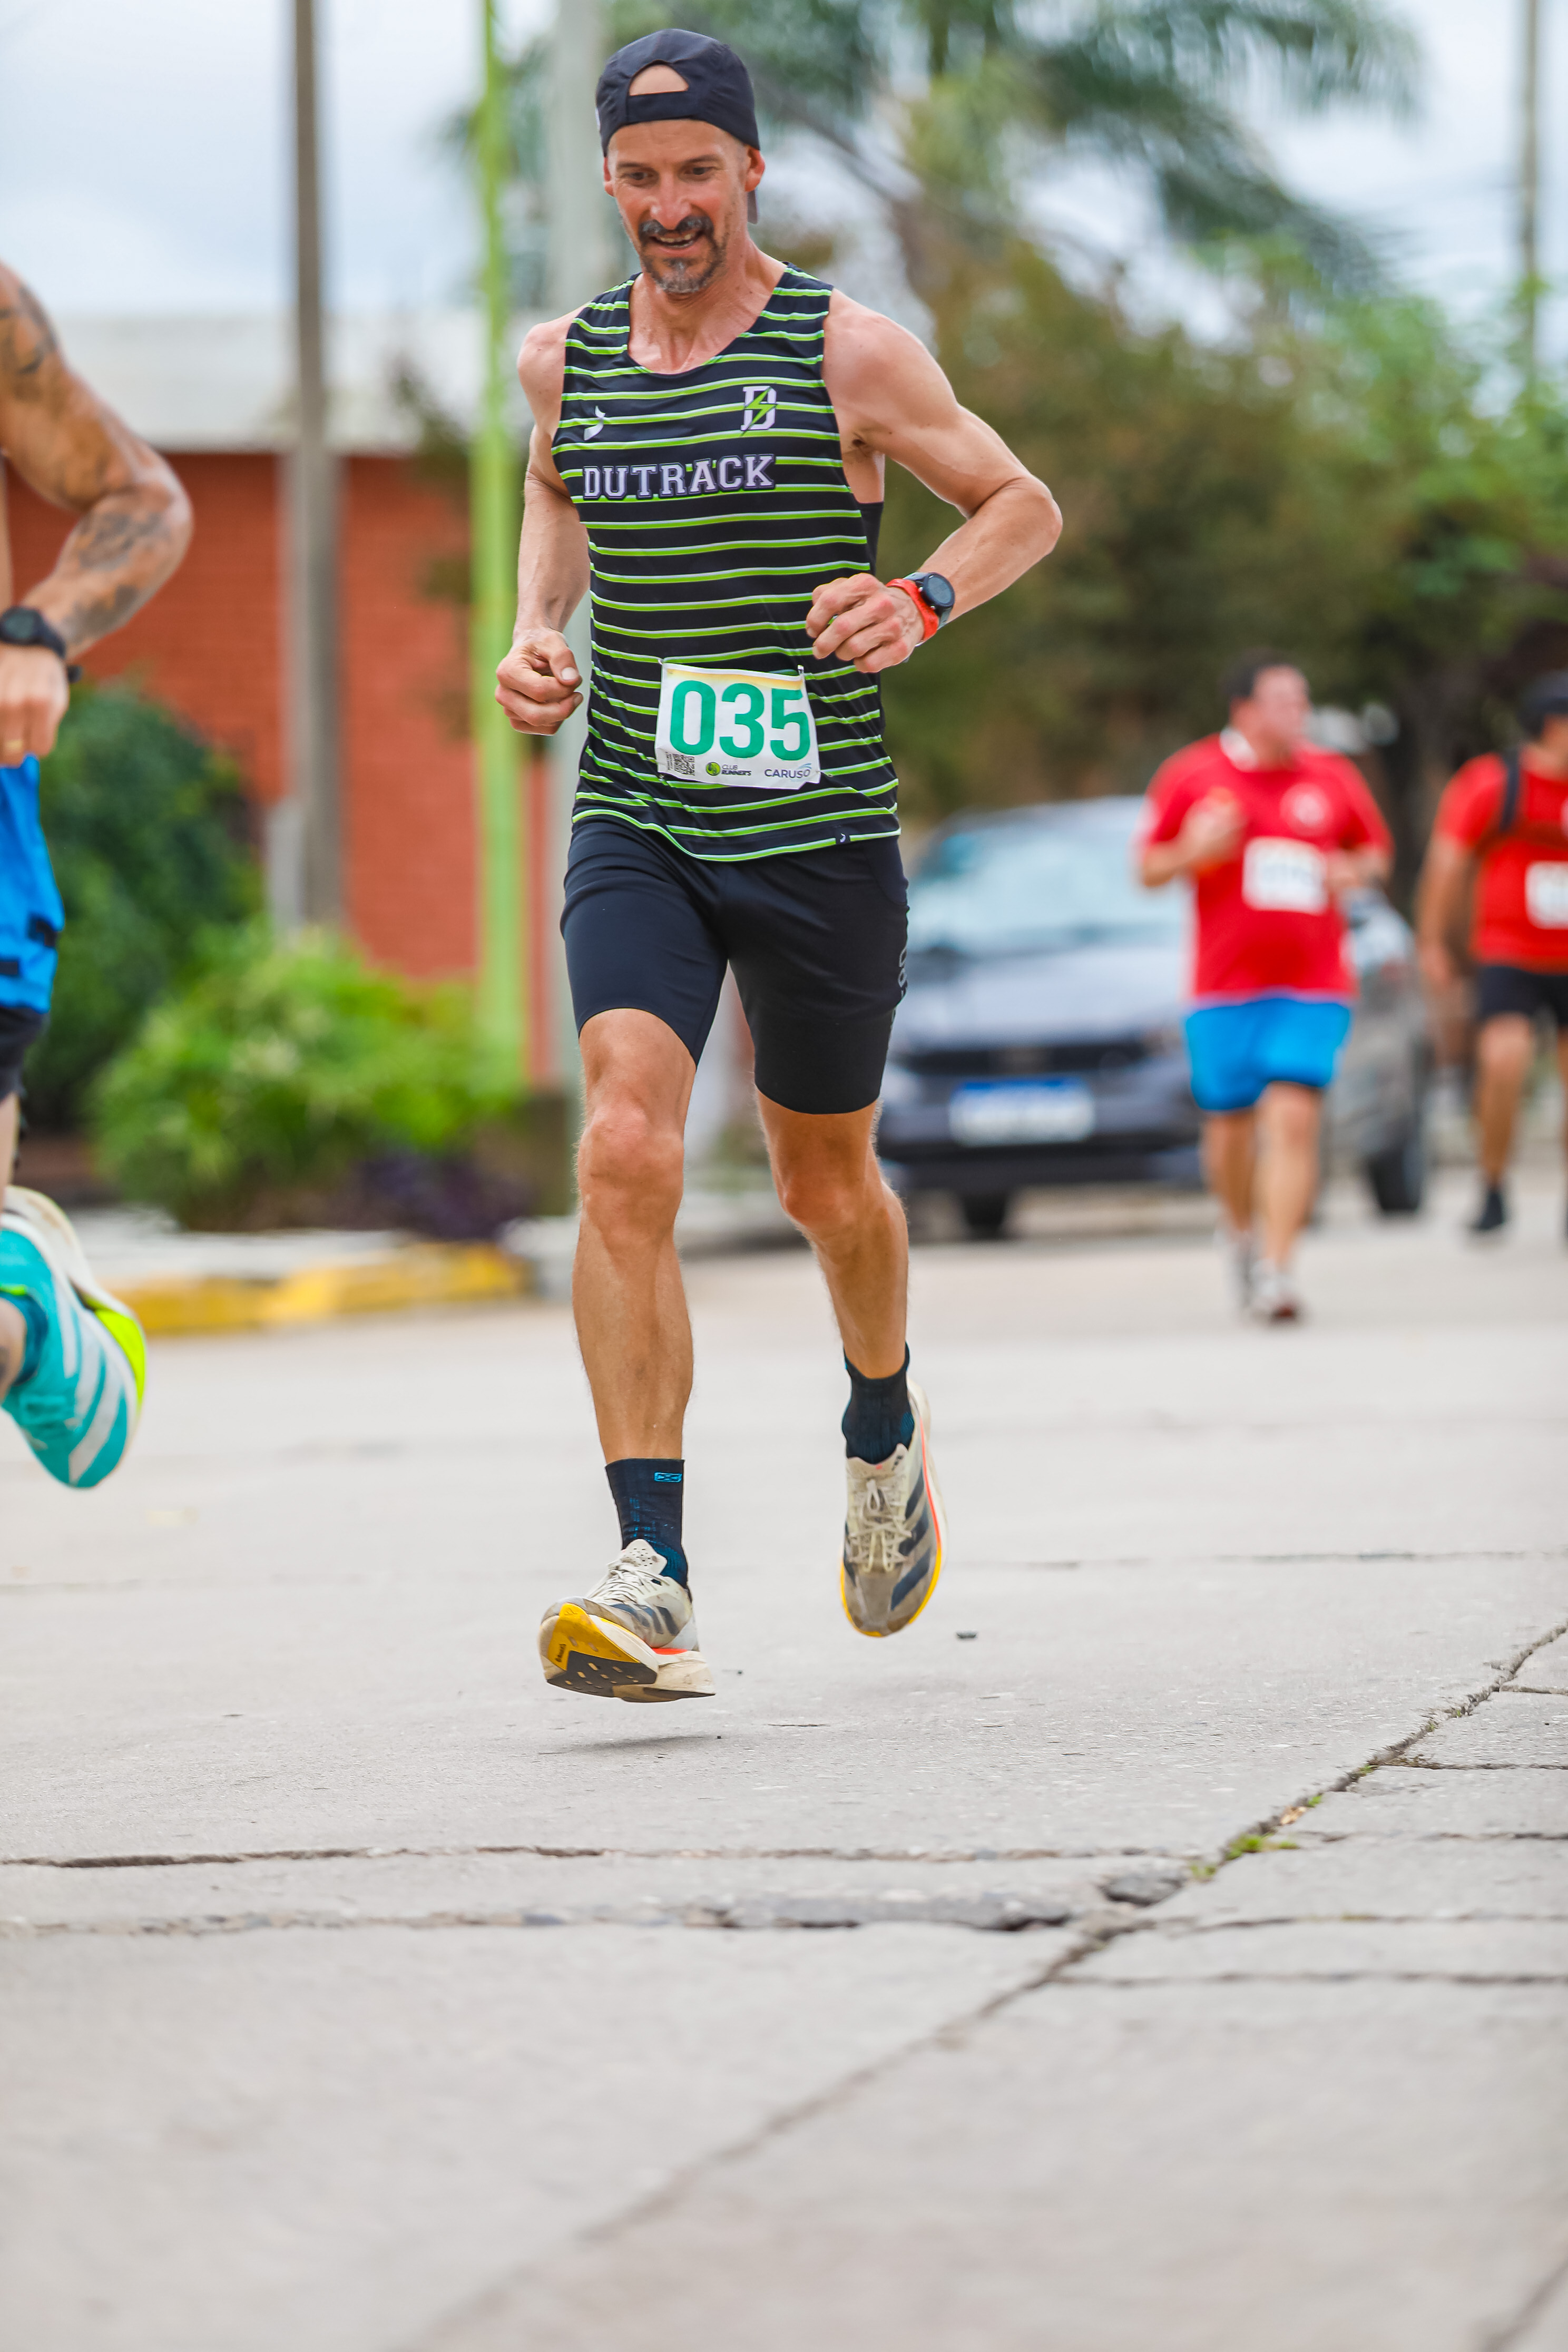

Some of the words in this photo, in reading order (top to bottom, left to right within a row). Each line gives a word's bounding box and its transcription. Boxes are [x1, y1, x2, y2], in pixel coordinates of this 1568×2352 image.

[583, 454, 776, 500] DUTRACK
[670, 680, 810, 761] 035
[764, 769, 811, 779] CARUSO
